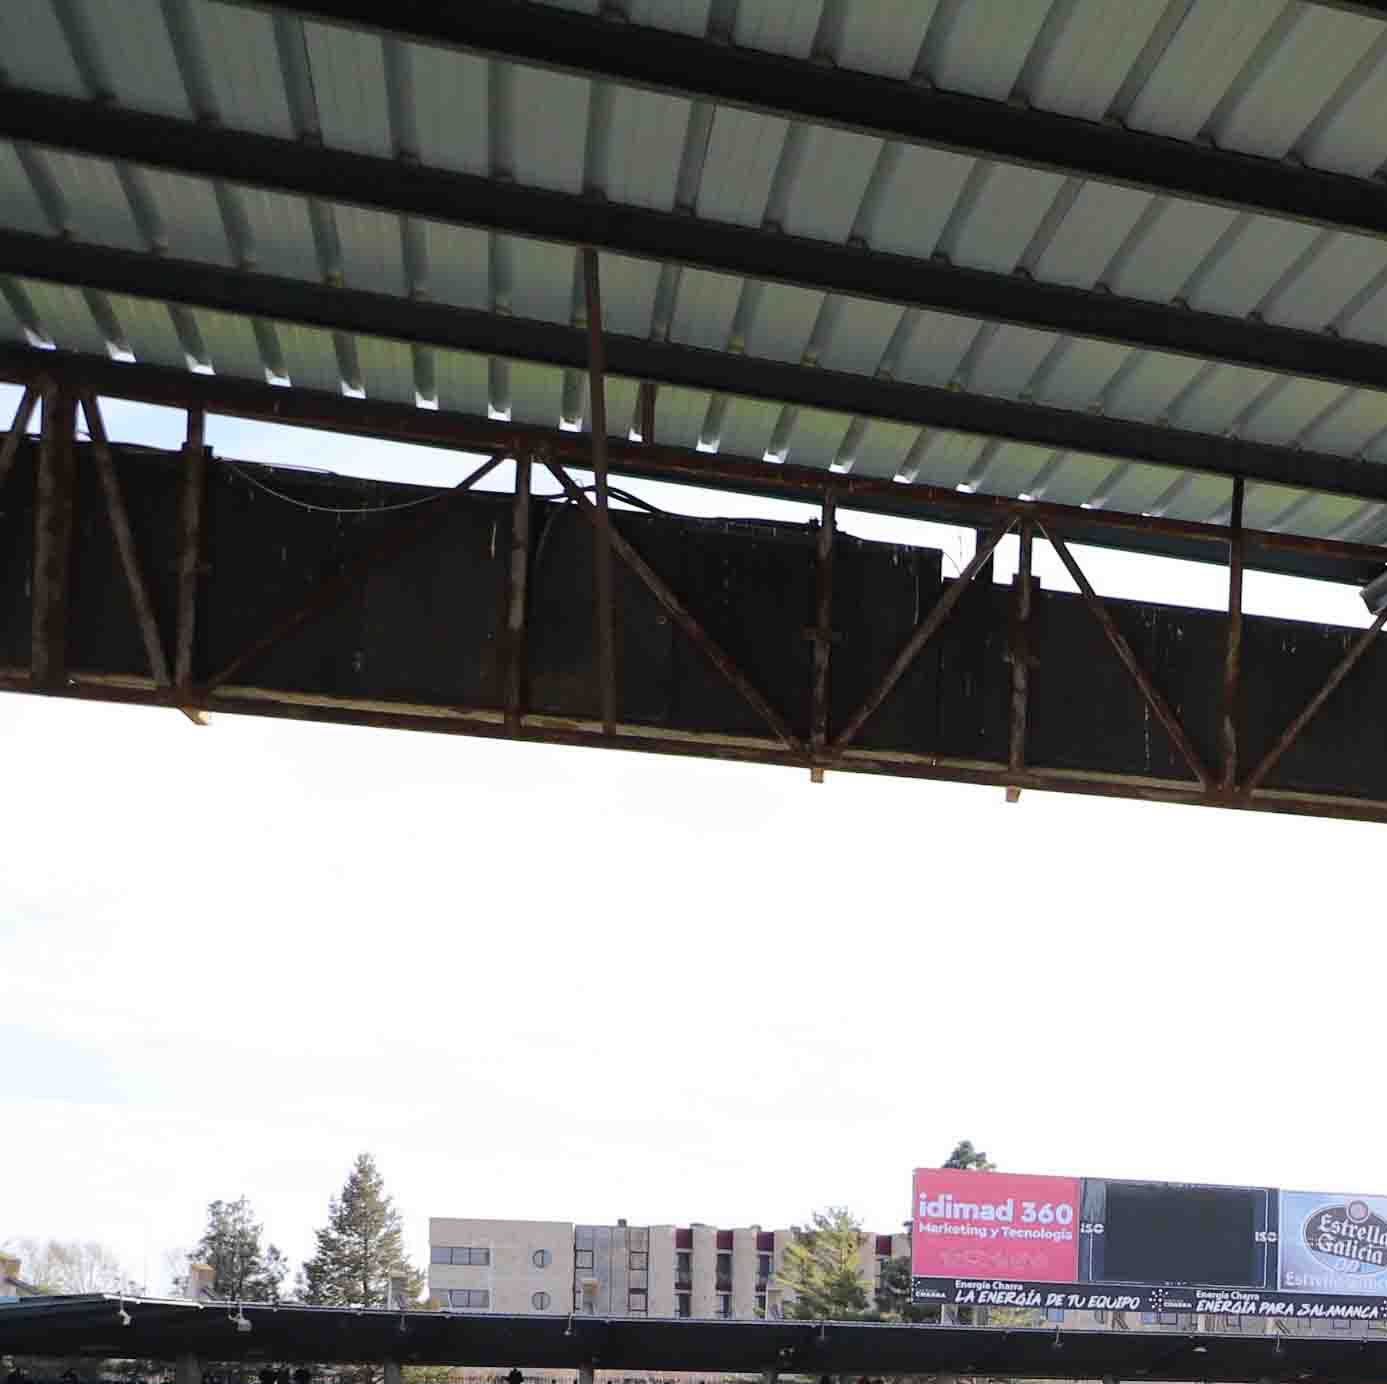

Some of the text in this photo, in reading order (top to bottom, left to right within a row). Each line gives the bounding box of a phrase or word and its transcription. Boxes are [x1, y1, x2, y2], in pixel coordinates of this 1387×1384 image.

[919, 1192, 1072, 1224] idimad 360
[919, 1223, 987, 1238] Marketing
[1318, 1233, 1384, 1264] Galicia
[955, 1290, 975, 1303] LA
[1046, 1294, 1067, 1306] DE
[1068, 1295, 1087, 1308] TU
[1088, 1295, 1141, 1310] EQUIPO
[1258, 1301, 1294, 1316] PARA
[1297, 1302, 1379, 1320] SALAMANCA
